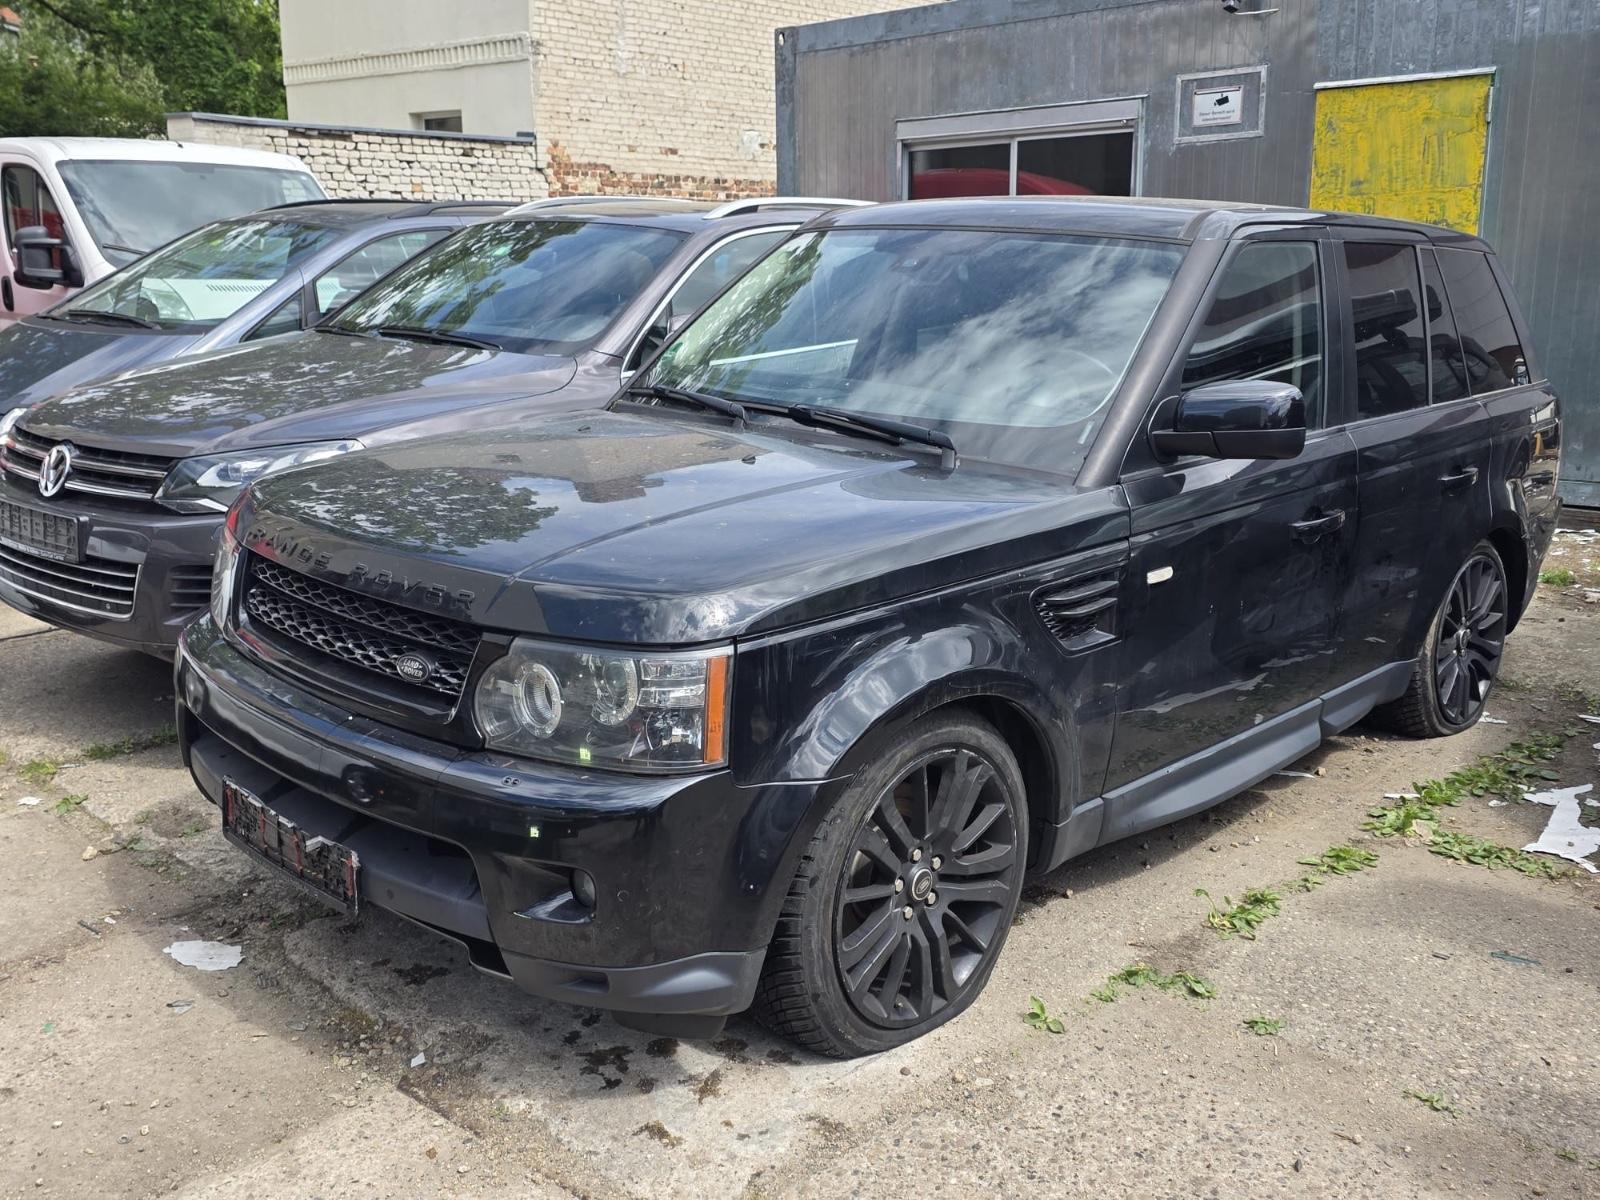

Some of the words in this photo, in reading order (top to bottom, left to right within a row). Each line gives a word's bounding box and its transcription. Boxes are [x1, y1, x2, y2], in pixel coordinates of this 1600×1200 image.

[247, 526, 333, 569] RANGE
[350, 563, 475, 610] ROVER
[403, 658, 419, 669] LAND
[403, 666, 423, 678] ROVER
